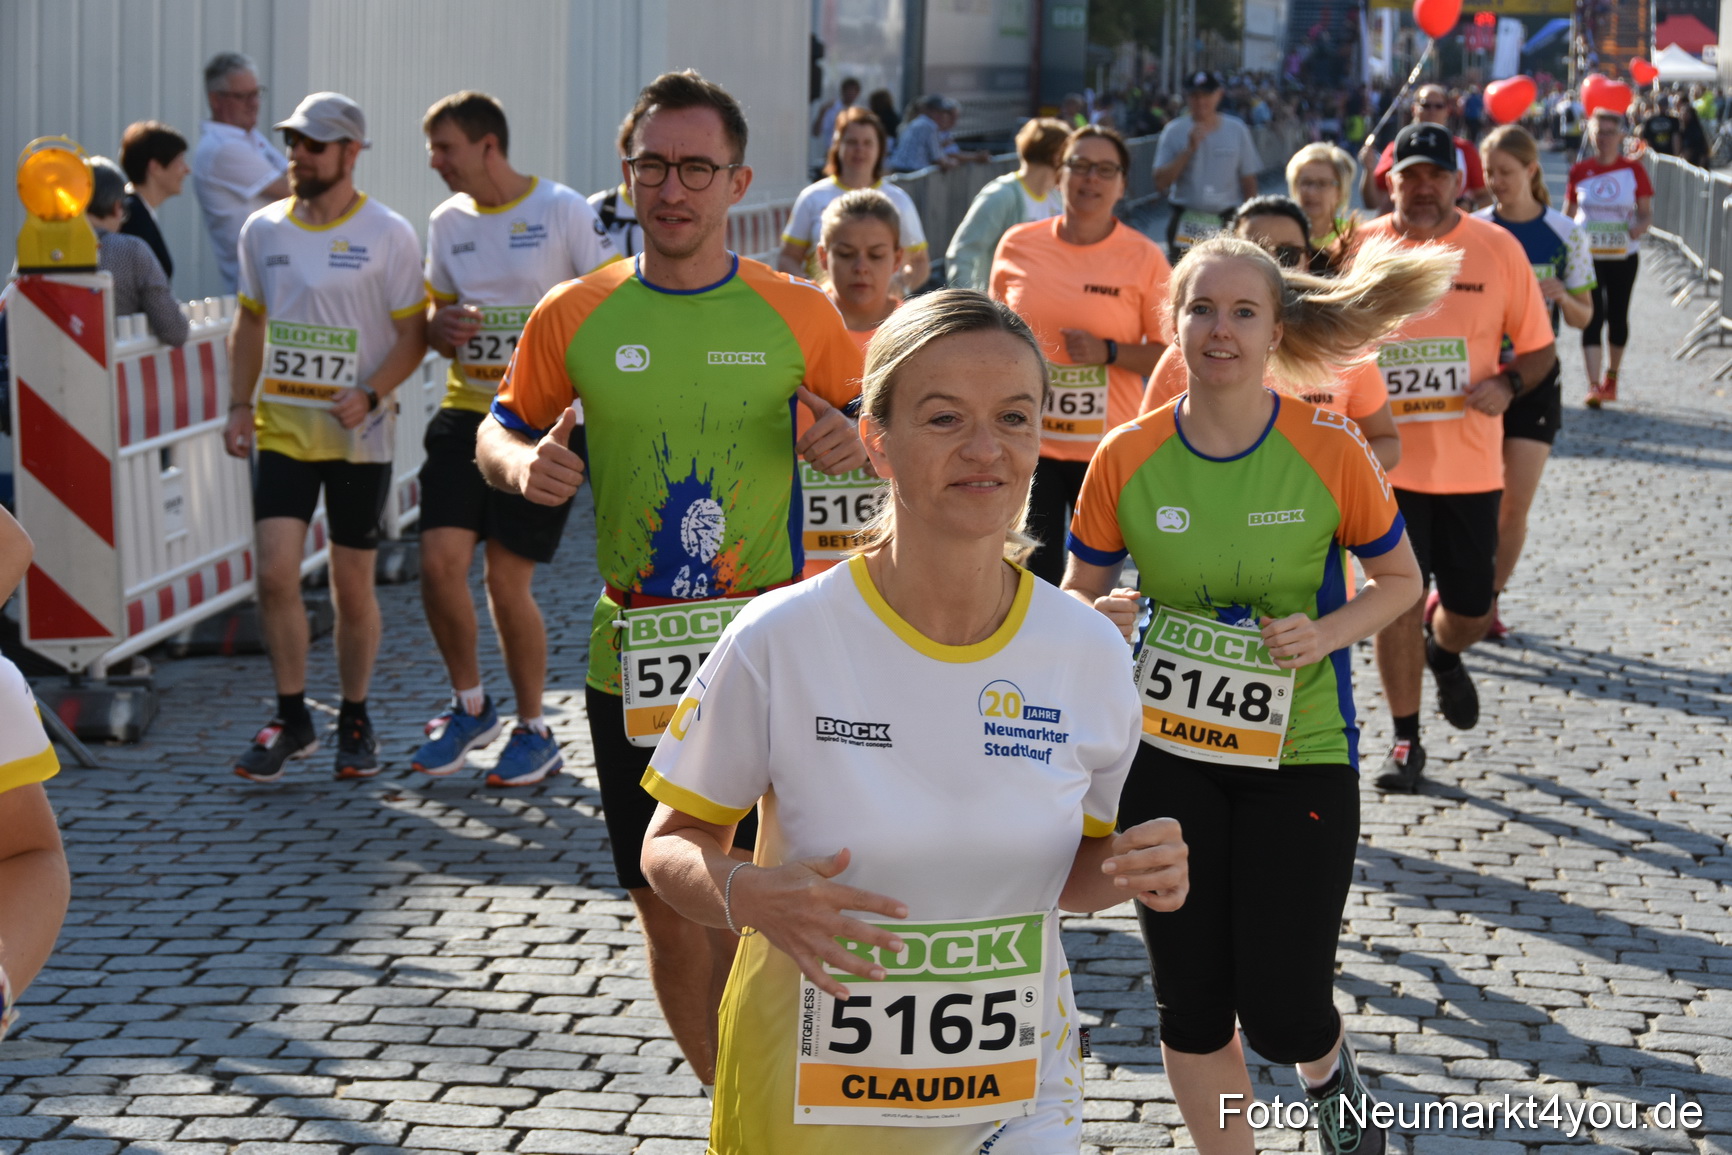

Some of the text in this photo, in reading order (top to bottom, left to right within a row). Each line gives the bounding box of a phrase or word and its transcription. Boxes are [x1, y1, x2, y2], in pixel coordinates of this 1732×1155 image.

[1084, 284, 1120, 297] THULE
[271, 323, 351, 348] BOCK
[273, 349, 346, 380] 5217
[707, 351, 767, 365] BOCK
[1387, 366, 1458, 395] 5241
[1403, 401, 1445, 412] DAVID
[1248, 509, 1306, 526] BOCK
[1156, 615, 1282, 672] BOCK
[638, 652, 711, 699] 52
[1145, 658, 1273, 723] 5148
[1277, 688, 1285, 698] S
[985, 690, 1058, 720] 20 JAHRE
[816, 716, 892, 741] BOCK
[984, 722, 1070, 743] Neumarkter
[1160, 717, 1240, 750] LAURA
[984, 742, 1053, 764] Stadtlauf
[1025, 991, 1034, 1003] S
[829, 989, 1016, 1055] 5165
[841, 1074, 1000, 1102] CLAUDIA
